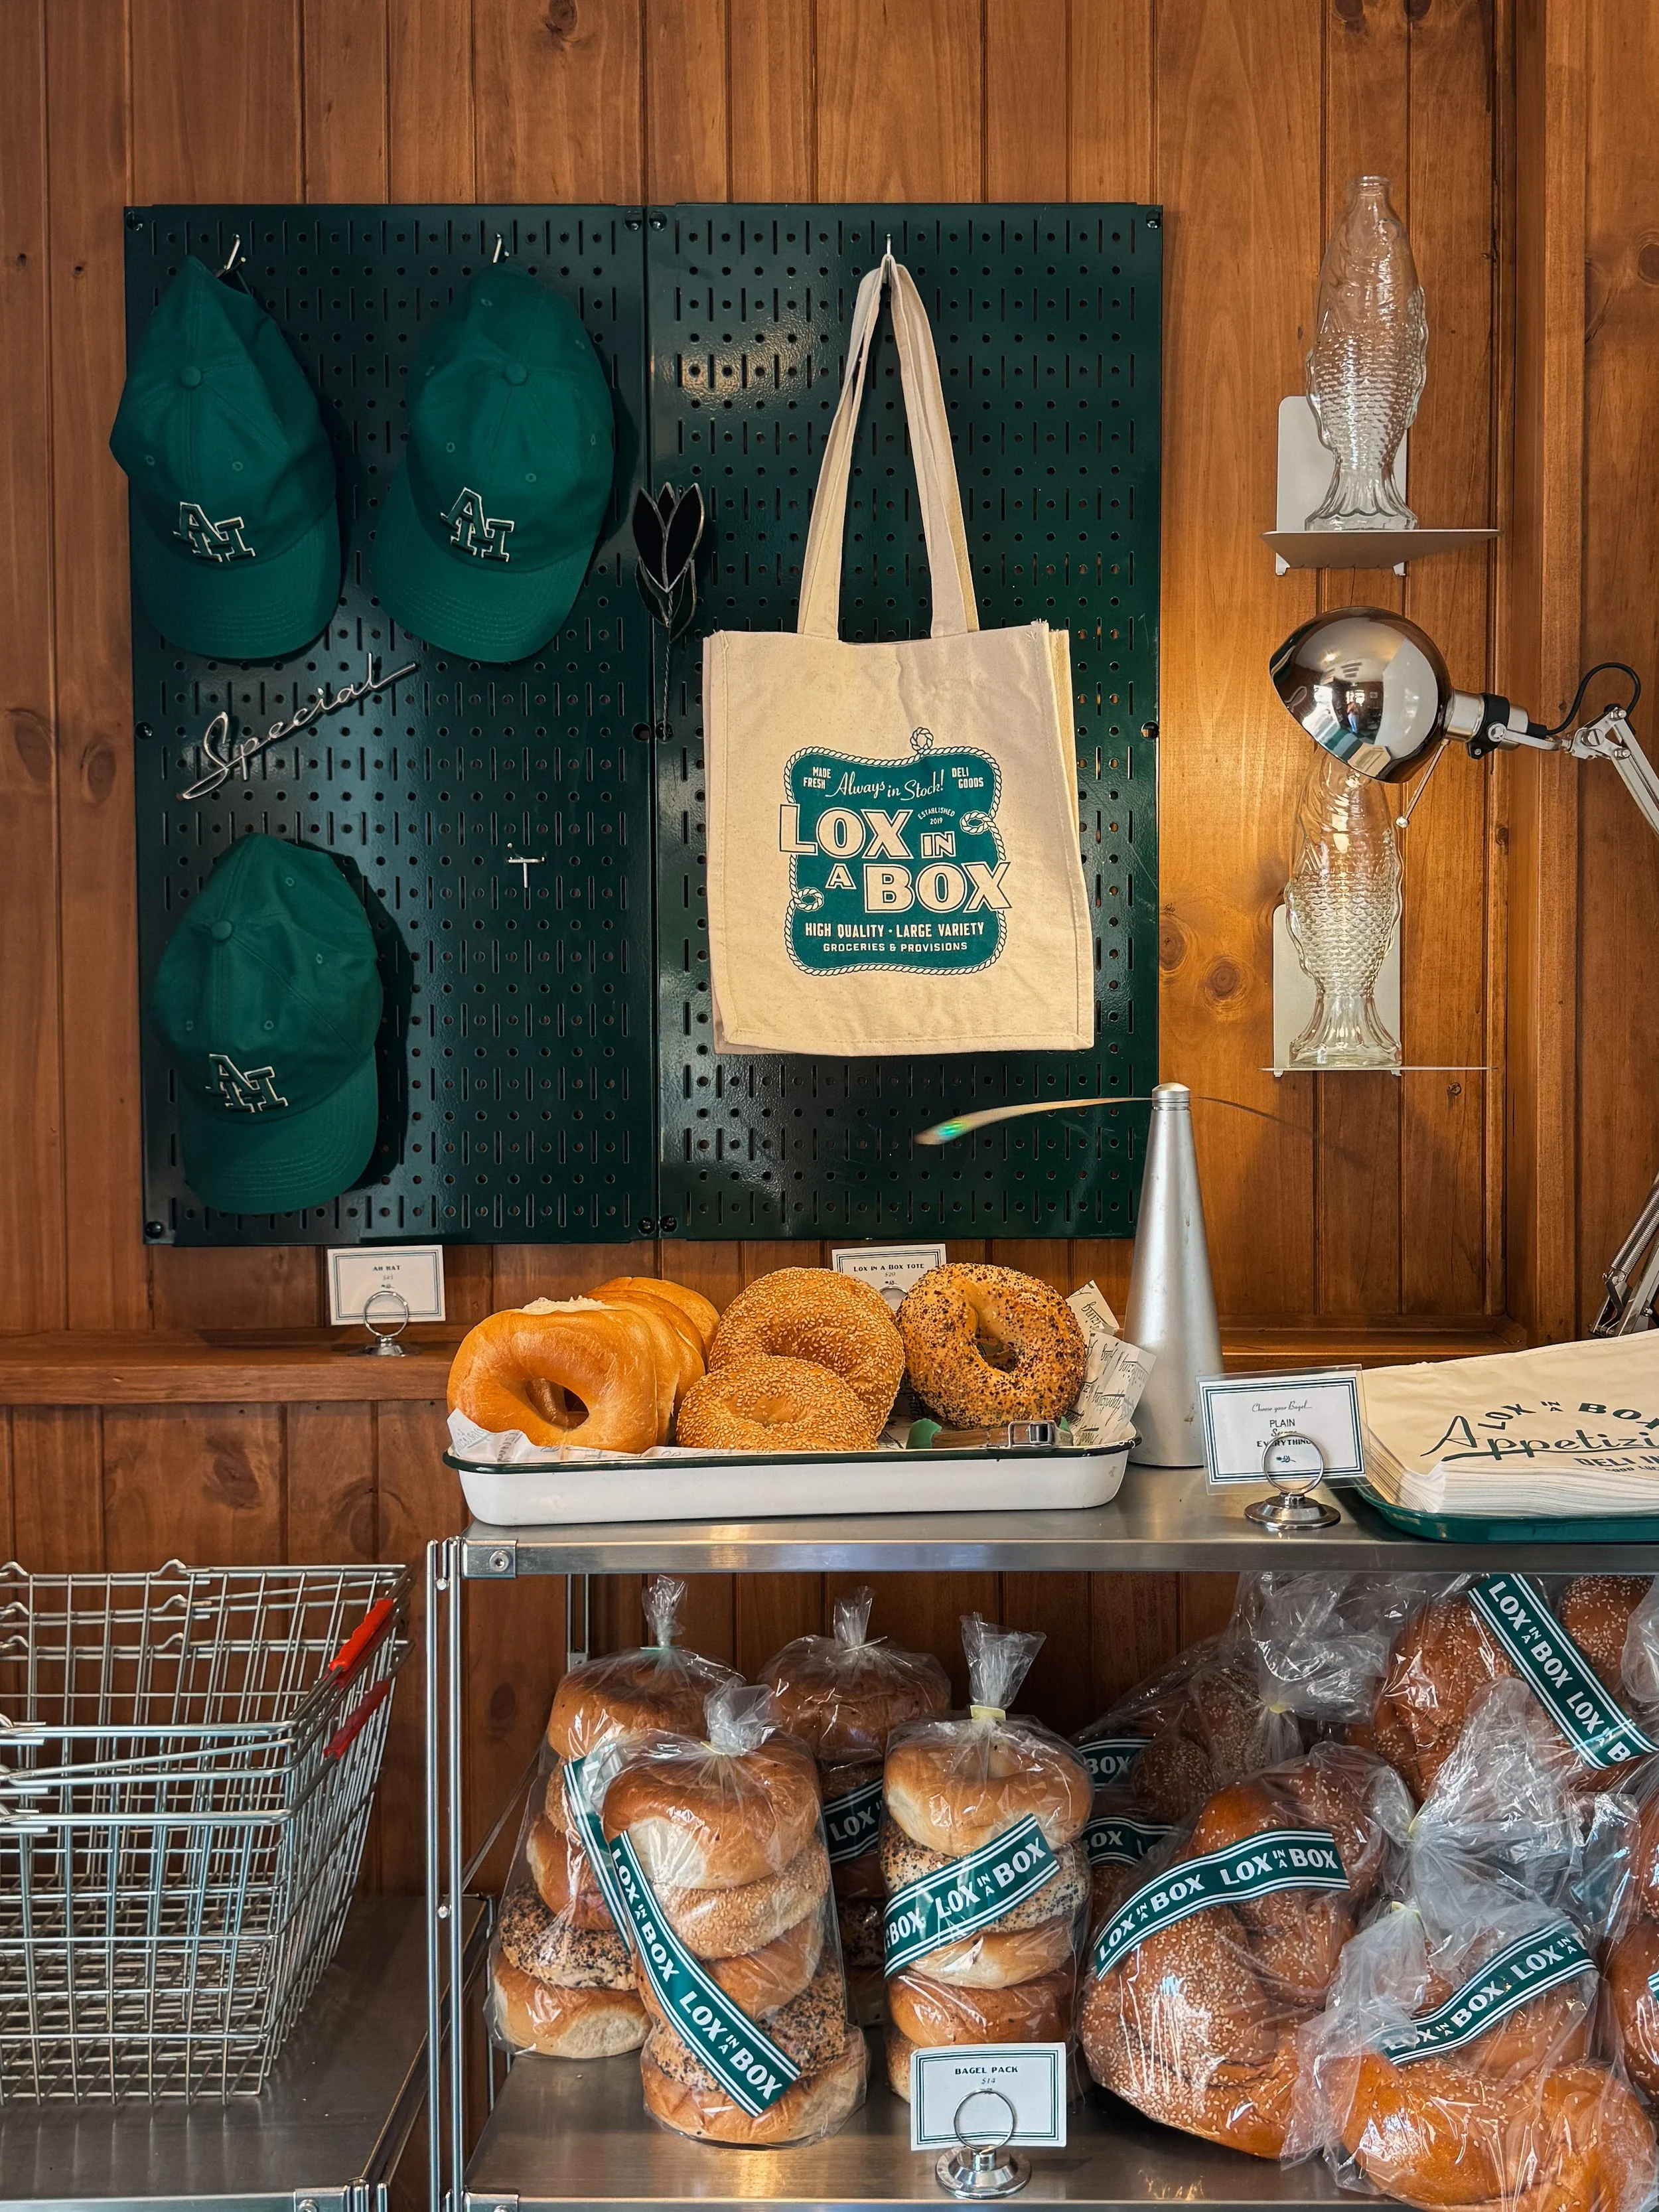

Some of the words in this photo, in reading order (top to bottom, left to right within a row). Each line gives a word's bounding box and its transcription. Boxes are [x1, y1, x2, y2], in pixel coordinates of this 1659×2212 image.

[182, 652, 417, 800] Special
[812, 767, 831, 779] MADE
[952, 767, 970, 778] DELI
[958, 776, 984, 789] GOODS
[803, 777, 826, 790] FRESH
[825, 771, 885, 799] Always
[887, 784, 901, 798] in
[900, 769, 945, 801] Stock!
[918, 807, 956, 820] ESTABLISHED
[779, 803, 914, 859] LOX
[920, 831, 956, 859] IN
[825, 863, 857, 890] A
[863, 861, 1013, 913] BOX
[805, 922, 832, 937] HIGH
[837, 923, 885, 939] QUALITY
[896, 923, 932, 938] LARGE
[938, 921, 985, 937] VARIETY
[823, 942, 886, 952] GROCERIES
[889, 943, 897, 952] &
[901, 941, 968, 952] PROVISIONS
[1252, 1402, 1272, 1412] Choose
[1478, 1403, 1536, 1430] LOX
[1269, 1418, 1295, 1428] PLAIN
[1256, 1439, 1312, 1447] EVRYTHIN
[1573, 1457, 1636, 1467] DELI
[1488, 1580, 1532, 1631] LOX
[1521, 1635, 1532, 1645] A
[1528, 1626, 1542, 1641] IN
[1530, 1640, 1573, 1689] BOX
[1566, 1691, 1605, 1735] LOX
[1595, 1736, 1606, 1747] A
[830, 1806, 876, 1842] LOX
[1272, 1848, 1285, 1860] IN
[1278, 1859, 1288, 1869] A
[1288, 1848, 1339, 1870] BOX
[935, 1881, 981, 1919] LOX
[977, 1873, 991, 1887] IN
[985, 1885, 995, 1897] A
[992, 1837, 1046, 1889] BOX
[1220, 1852, 1273, 1886] LOX
[1149, 1874, 1206, 1913] BOX
[612, 1848, 640, 1904] LOX
[642, 1921, 680, 1982] BOX
[1136, 1902, 1148, 1916] IN
[1140, 1911, 1149, 1922] A
[889, 1907, 926, 1945] BOX
[1099, 1912, 1136, 1962] LOX
[1510, 1945, 1564, 1981] LOX
[1557, 1936, 1572, 1948] IN
[1567, 1945, 1578, 1954] A
[1435, 2022, 1450, 2031] IN
[1450, 1980, 1505, 2029] BOX
[679, 1990, 728, 2042] LOX
[718, 2044, 729, 2055] A
[725, 2034, 740, 2050] IN
[729, 2049, 783, 2101] BOX
[955, 2067, 987, 2075] BAGEL
[991, 2065, 1019, 2074] PACK
